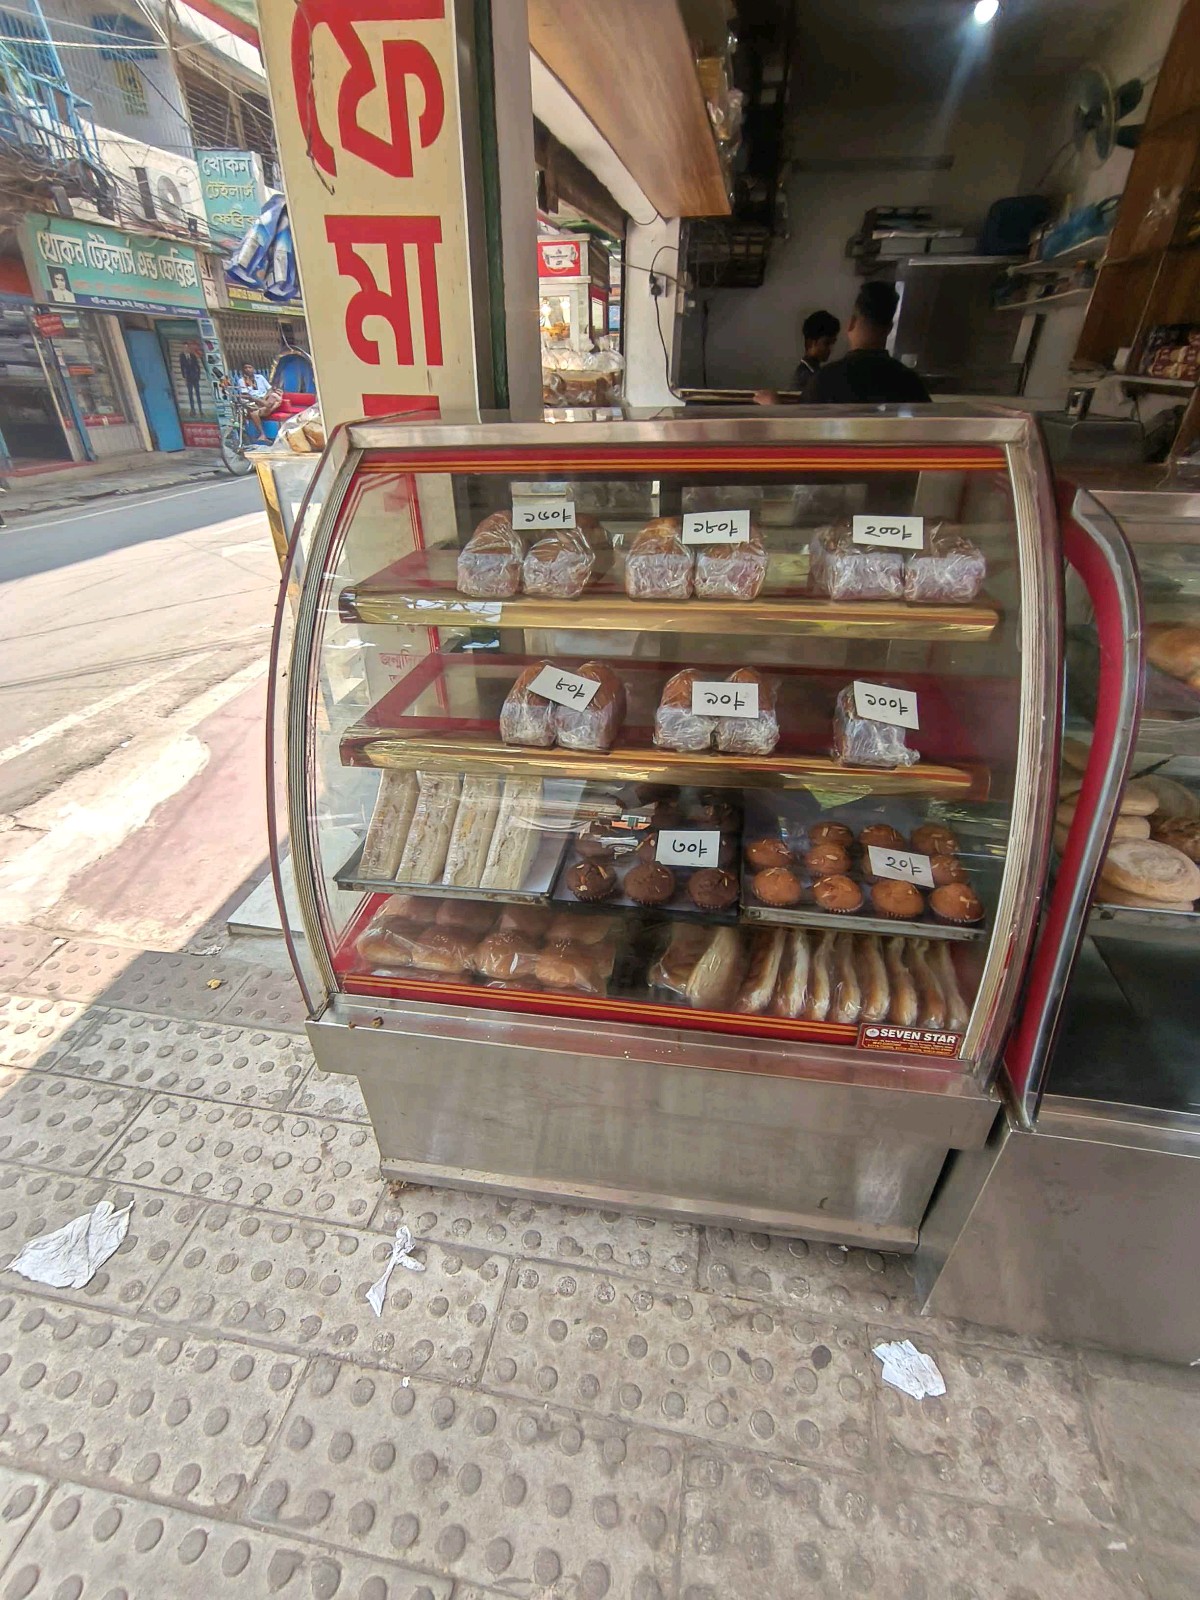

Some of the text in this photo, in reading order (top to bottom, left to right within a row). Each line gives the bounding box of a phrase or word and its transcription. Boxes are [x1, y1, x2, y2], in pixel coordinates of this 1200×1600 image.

[202, 155, 252, 178] খোকন
[291, 0, 446, 420] ফেমা
[37, 230, 87, 267] খোকন
[87, 232, 136, 275] টেইলার্স
[880, 1028, 956, 1043] SEVEN STAR
